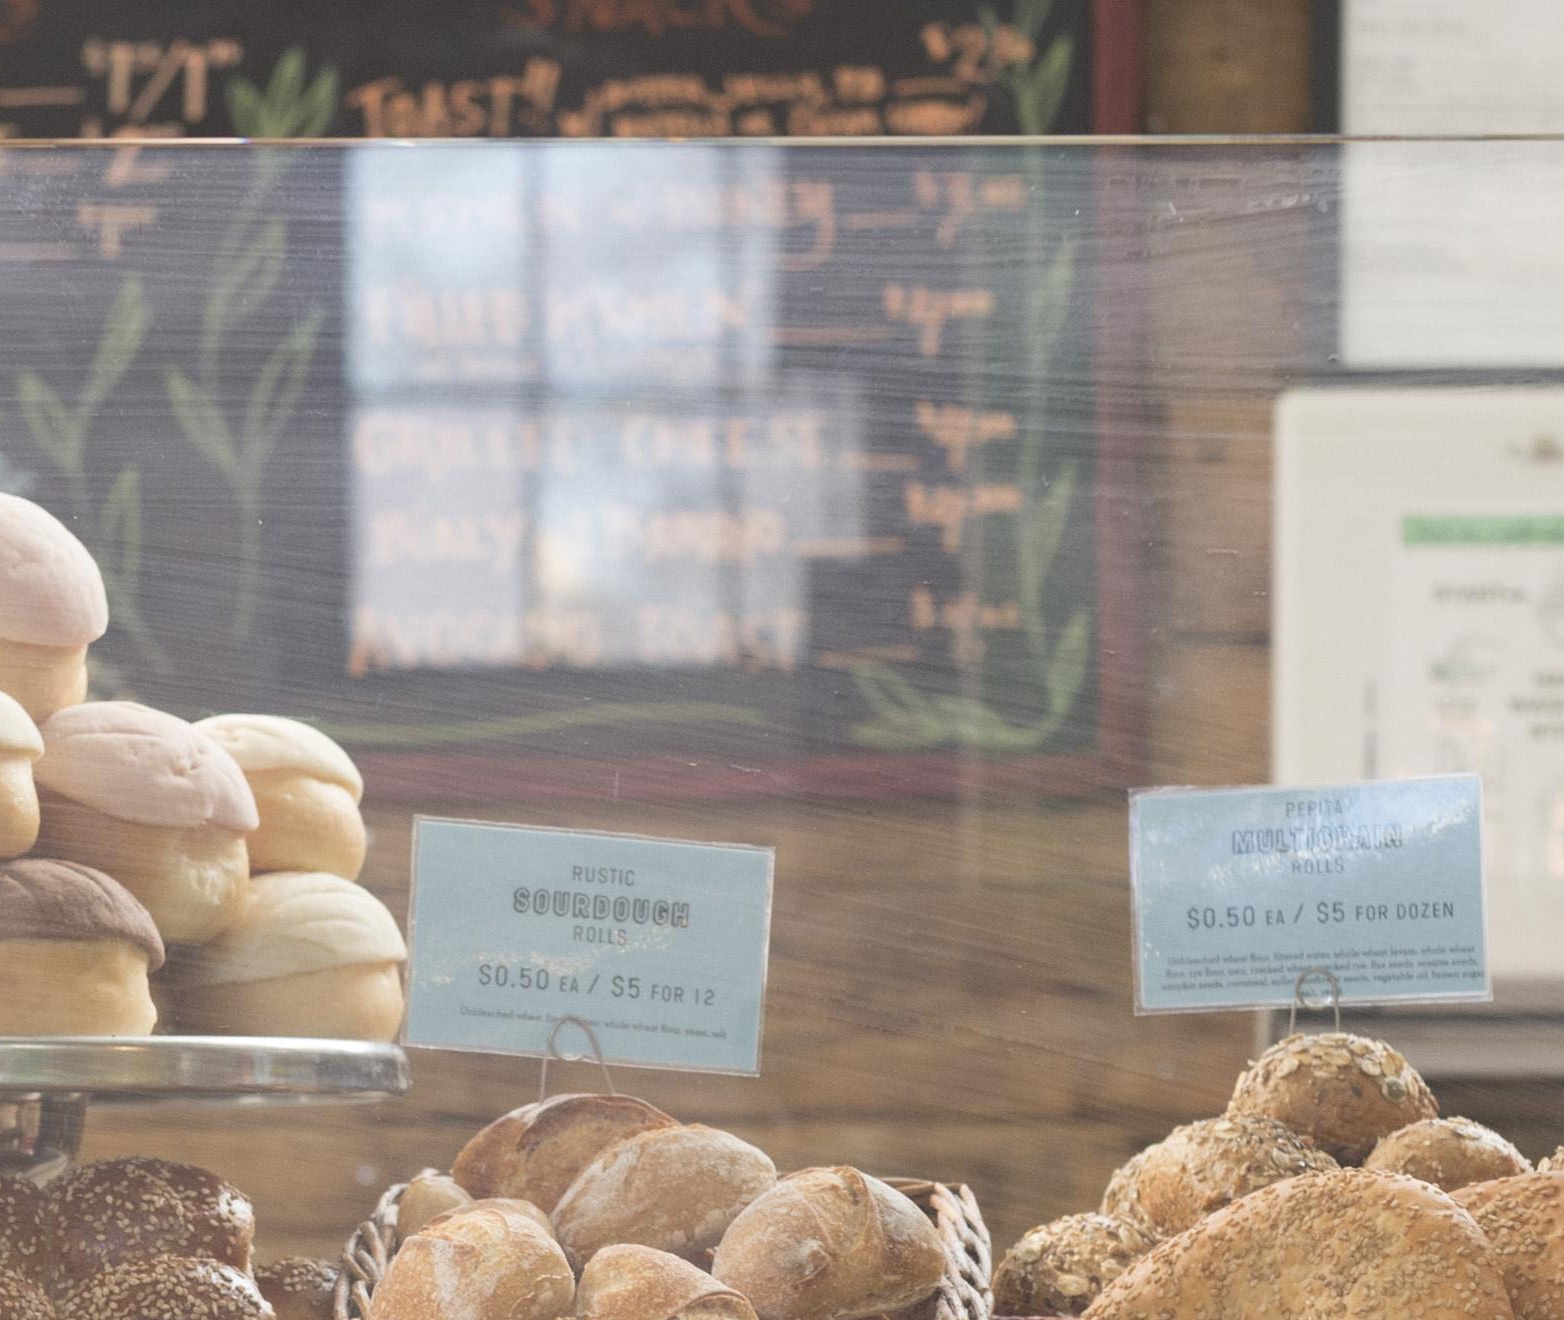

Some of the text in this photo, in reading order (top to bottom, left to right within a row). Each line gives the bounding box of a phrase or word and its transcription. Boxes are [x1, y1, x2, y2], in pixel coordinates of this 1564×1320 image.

[572, 865, 635, 887] RUSTIC
[1292, 858, 1344, 875] ROLLS
[513, 886, 690, 928] SOURDOUGH
[1187, 901, 1455, 930] $0.50 EA / $5 FOR DOZEN
[573, 925, 628, 946] ROLLS
[478, 964, 715, 1006] $0.50 EA / $5 FOR 12
